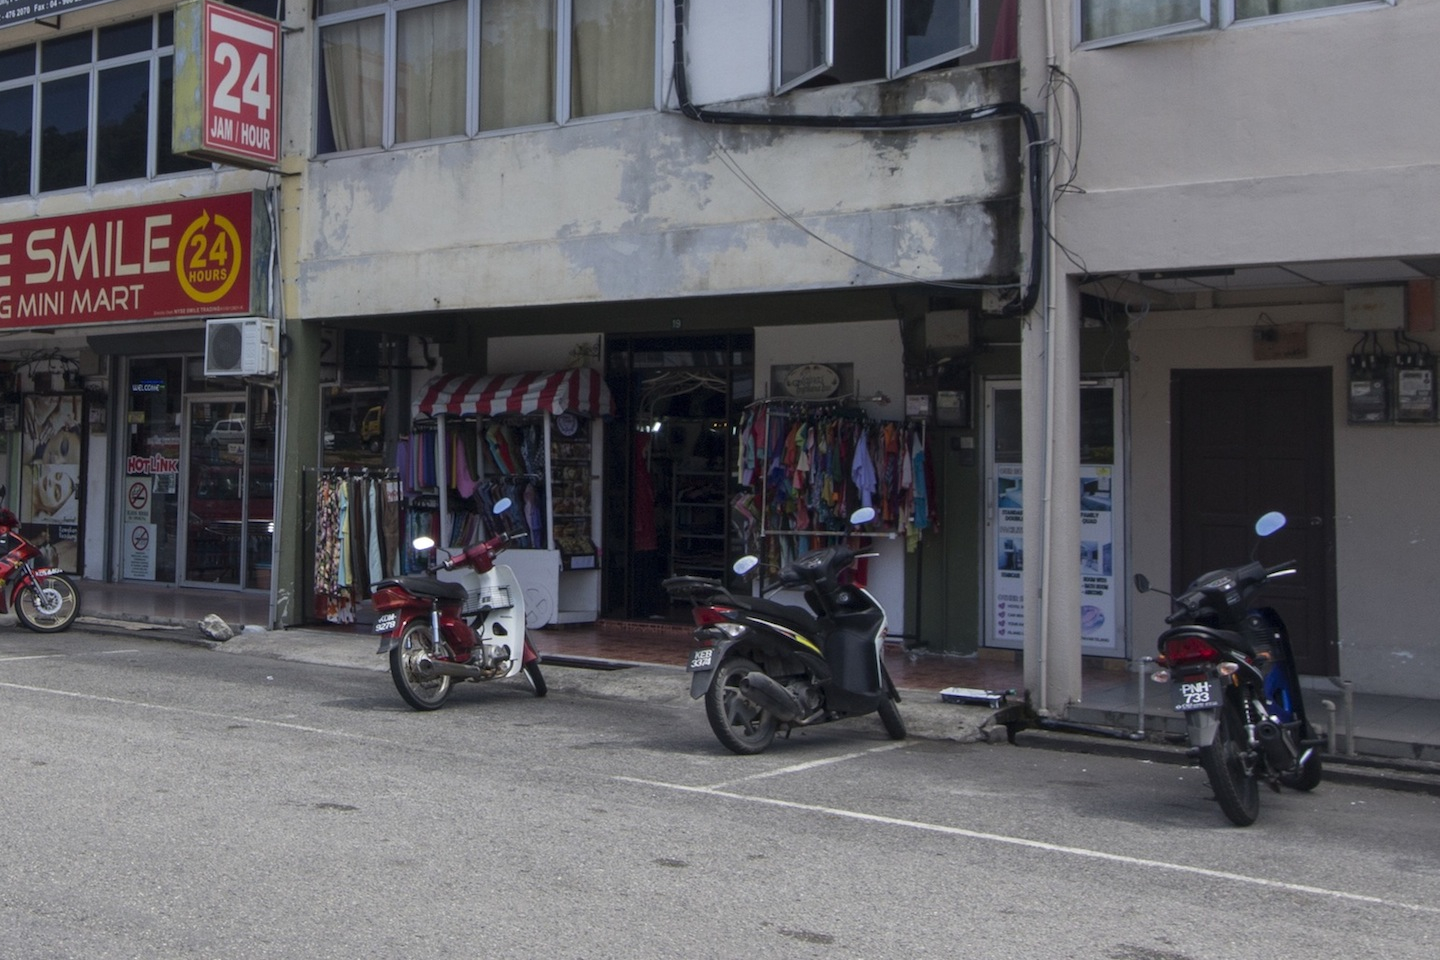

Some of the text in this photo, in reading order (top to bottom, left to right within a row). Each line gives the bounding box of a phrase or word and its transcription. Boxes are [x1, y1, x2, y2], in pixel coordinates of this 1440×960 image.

[34, 1, 45, 13] Fax
[213, 42, 271, 120] 24
[211, 116, 233, 141] JAM
[241, 123, 270, 150] HOUR
[25, 214, 172, 284] SMILE
[189, 231, 228, 269] 24
[189, 268, 227, 283] HOURS
[17, 291, 64, 318] MINI
[71, 284, 144, 314] MART
[132, 384, 160, 392] WELCOME
[1182, 681, 1209, 694] PNH
[1183, 692, 1210, 704] 733
